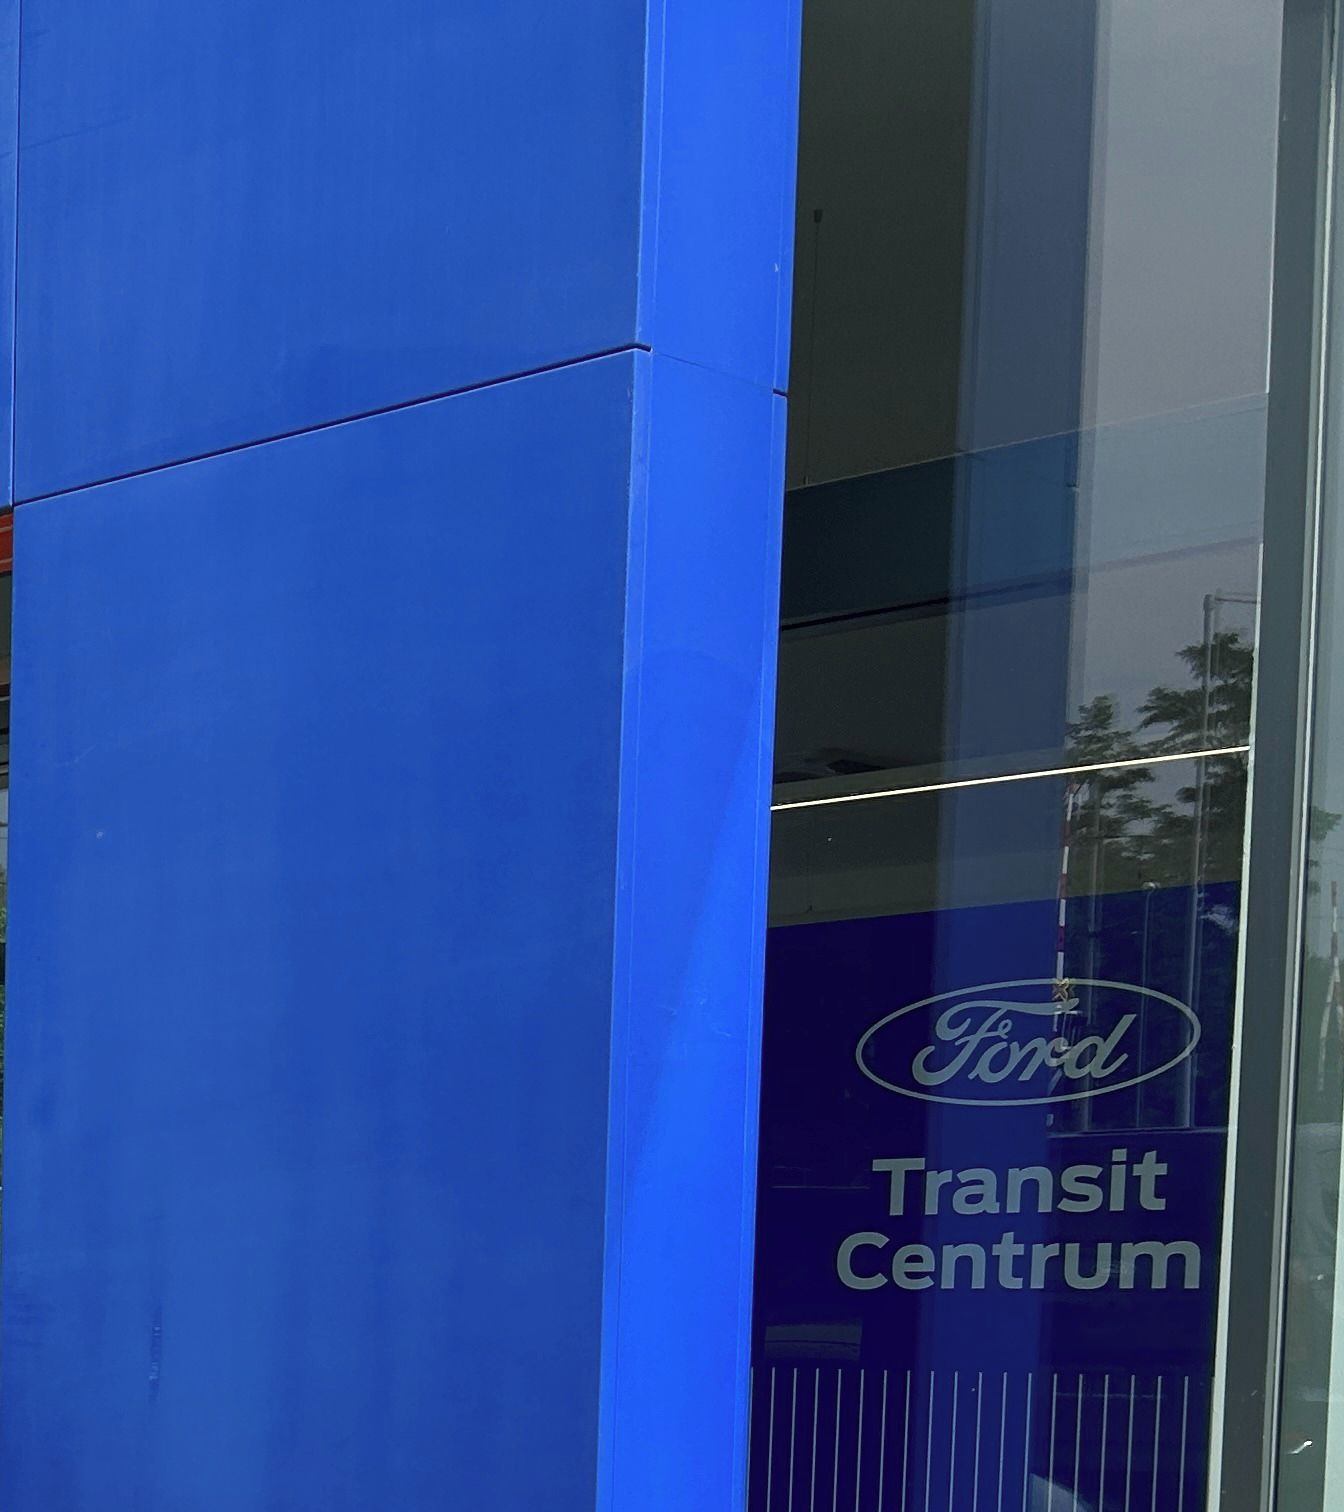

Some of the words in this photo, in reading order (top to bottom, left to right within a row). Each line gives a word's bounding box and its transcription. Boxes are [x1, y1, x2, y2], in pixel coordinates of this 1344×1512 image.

[912, 997, 1137, 1088] Ford
[872, 1147, 1168, 1217] Transit
[835, 1231, 1202, 1291] Centrum
